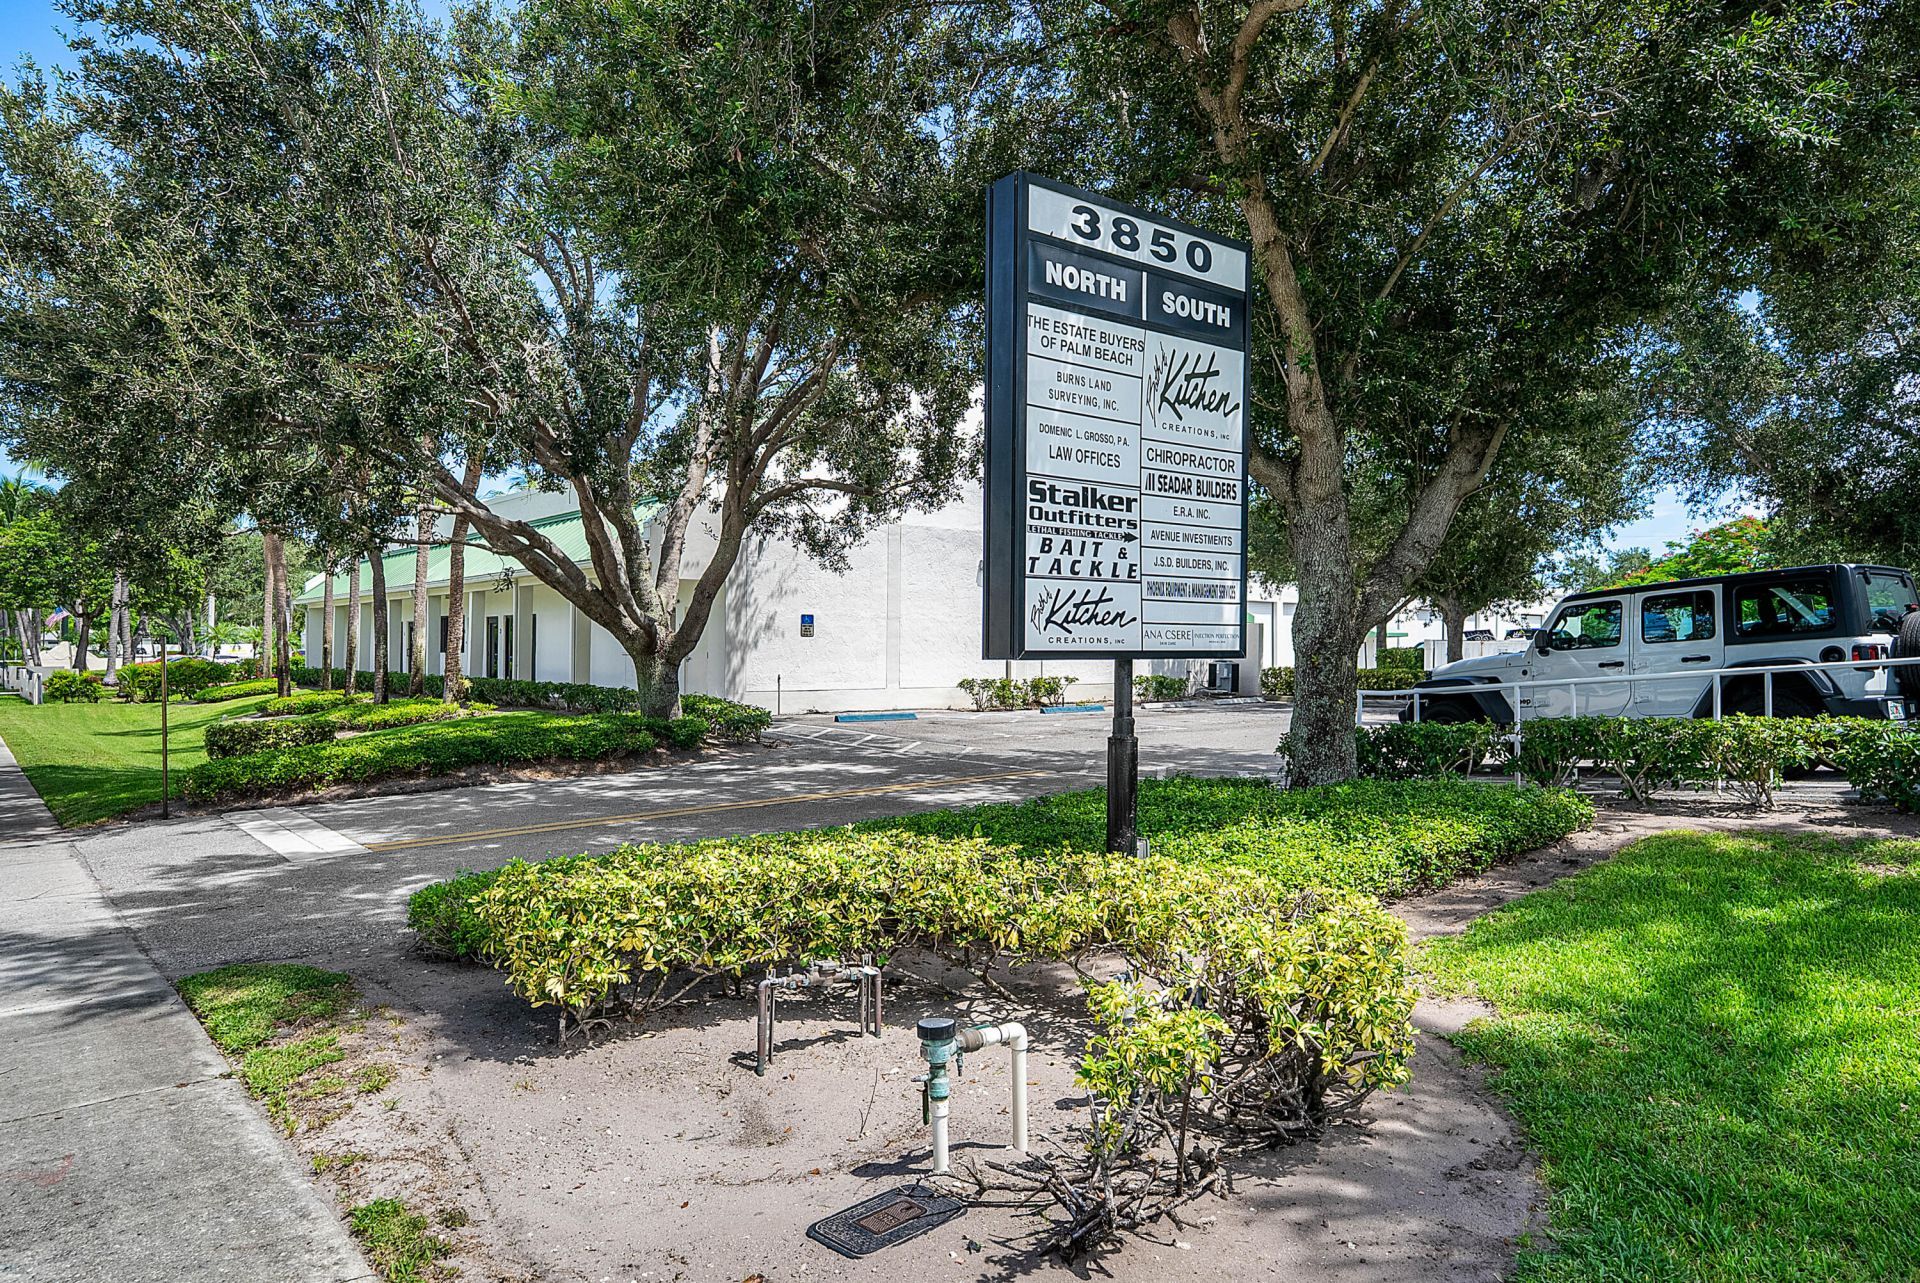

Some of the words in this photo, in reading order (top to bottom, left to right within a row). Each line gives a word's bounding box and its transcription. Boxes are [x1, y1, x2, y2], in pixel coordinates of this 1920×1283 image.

[1071, 205, 1212, 273] 3850
[1045, 260, 1126, 302] NORTH
[1162, 291, 1231, 328] SOUTH
[1027, 314, 1050, 332] THE
[1053, 320, 1096, 342] ESTATE
[1100, 331, 1144, 352] BUYERS
[1040, 335, 1057, 349] OF
[1060, 339, 1091, 357] PALM
[1095, 347, 1133, 366] BEACH
[1056, 371, 1086, 387] BURNS
[1088, 378, 1112, 392] LAND
[1158, 348, 1240, 422] Kitchen
[1048, 388, 1101, 410] SURVEYING,
[1103, 398, 1119, 411] INC.
[1039, 423, 1073, 438] DOMENIC
[1076, 429, 1082, 440] L.
[1084, 430, 1116, 446] GROSSO,
[1162, 422, 1218, 439] CREATIONS,
[1049, 444, 1073, 462] LAW
[1075, 448, 1121, 468] OFFICES
[1146, 447, 1236, 473] CHIROPRACTOR
[1029, 480, 1138, 513] Stalker
[1157, 473, 1193, 495] SEADAR
[1196, 479, 1237, 501] BUILDERS
[1029, 505, 1138, 530] Outfitters
[1173, 506, 1195, 518] E.R.A.
[1196, 508, 1211, 520] INC.
[1027, 525, 1056, 535] LETHAL
[1059, 528, 1092, 538] FISHING
[1093, 530, 1122, 541] TACKLE
[1150, 529, 1181, 542] AVENUE
[1182, 532, 1233, 547] INVESTMENTS
[1040, 537, 1104, 558] BAIT
[1118, 547, 1128, 560] &
[1028, 556, 1138, 579] TACKLE
[1154, 556, 1174, 568] J.S.D.
[1175, 558, 1214, 572] BUILDERS,
[1215, 561, 1229, 571] INC.
[1165, 581, 1188, 598] EQUIPMENT
[1191, 582, 1219, 599] MANAGEMENT
[1219, 584, 1236, 600] SERVICES
[1044, 585, 1138, 635] Kitchen
[1048, 636, 1112, 645] CREATIONS,
[1144, 629, 1163, 640] ANA
[1165, 629, 1192, 641] CSERE
